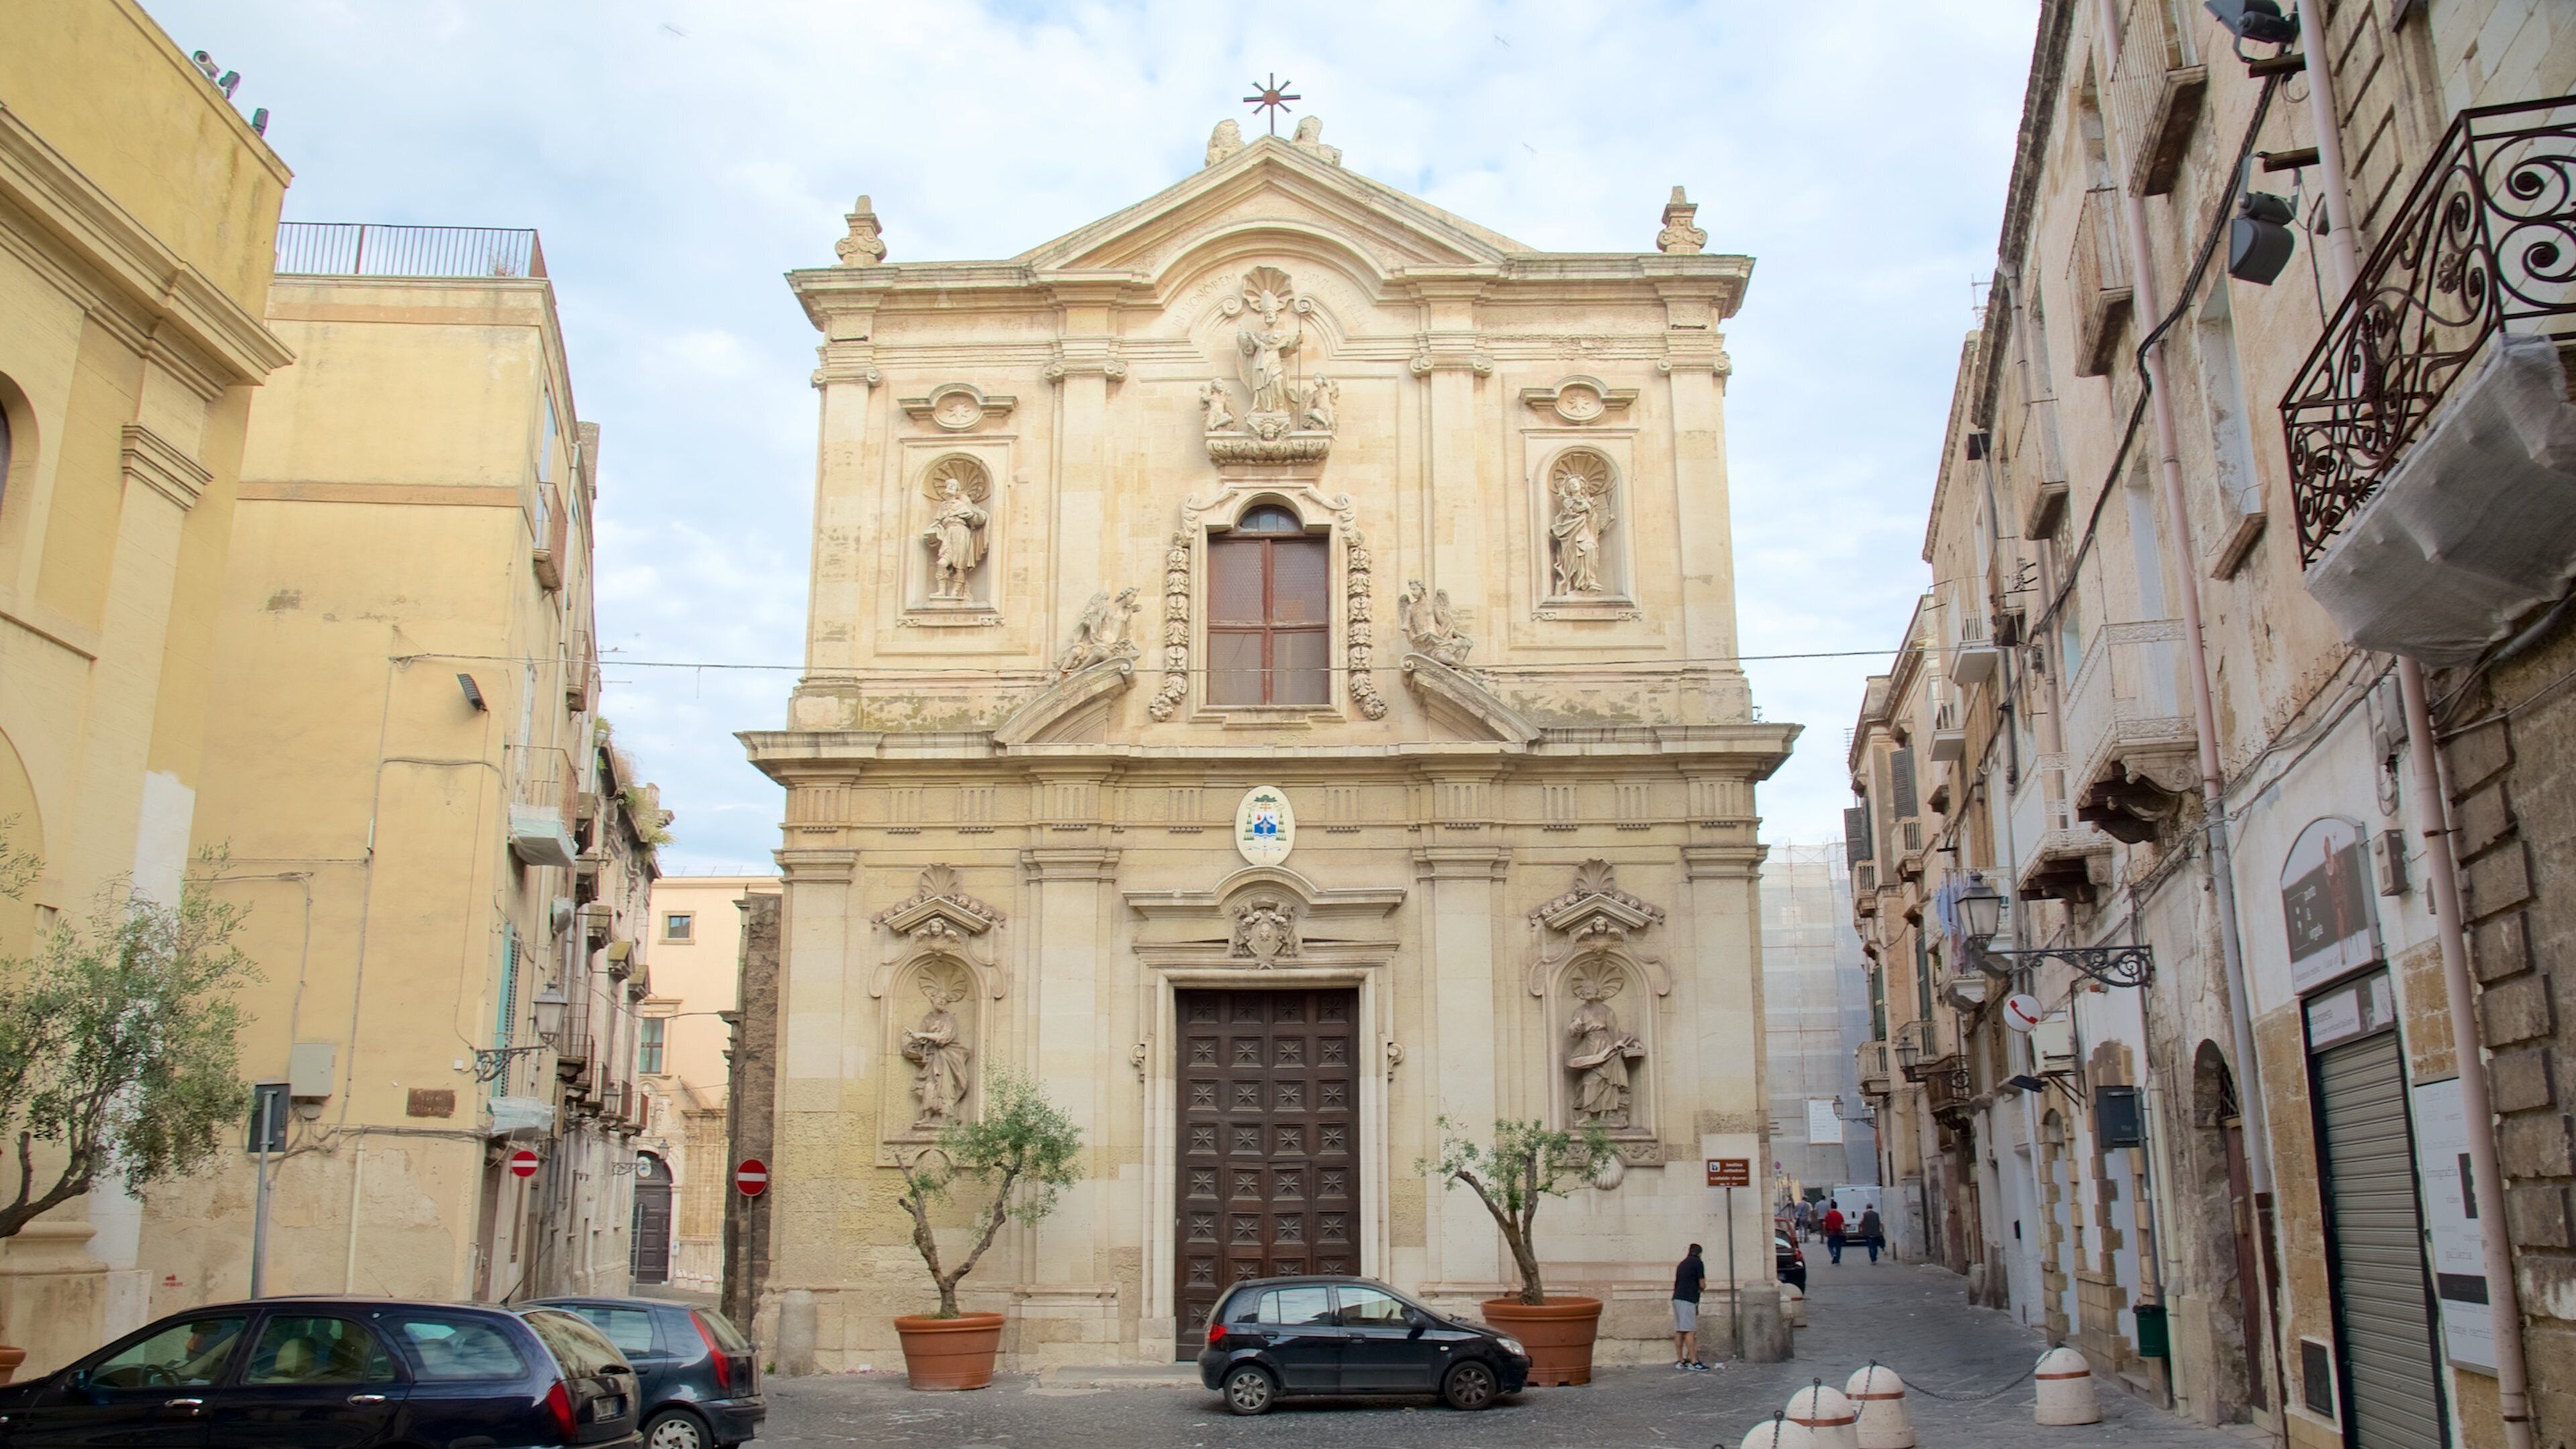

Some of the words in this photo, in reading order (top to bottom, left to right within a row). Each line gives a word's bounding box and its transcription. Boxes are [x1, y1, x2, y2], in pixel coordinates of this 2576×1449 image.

[1172, 315, 1186, 328] IN
[1181, 272, 1238, 314] HONOREM
[1300, 270, 1330, 290] DIVI
